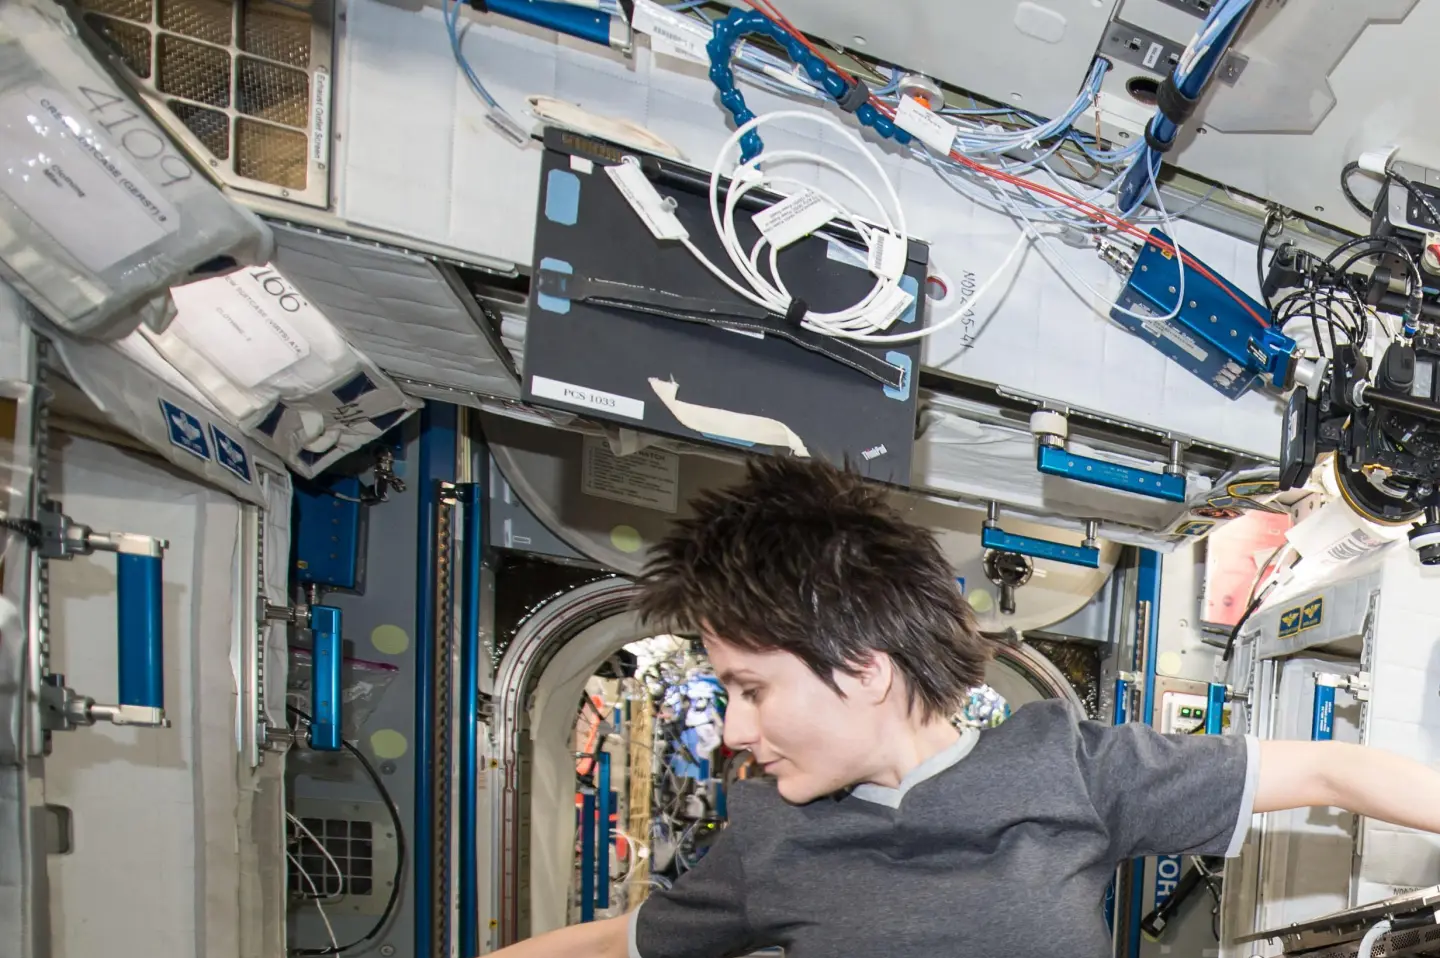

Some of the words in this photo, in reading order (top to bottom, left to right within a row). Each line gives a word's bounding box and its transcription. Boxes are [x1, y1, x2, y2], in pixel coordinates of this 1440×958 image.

[78, 86, 193, 187] 4109
[563, 388, 586, 402] PCS
[588, 394, 616, 408] 1033
[861, 444, 888, 461] ThinkPad
